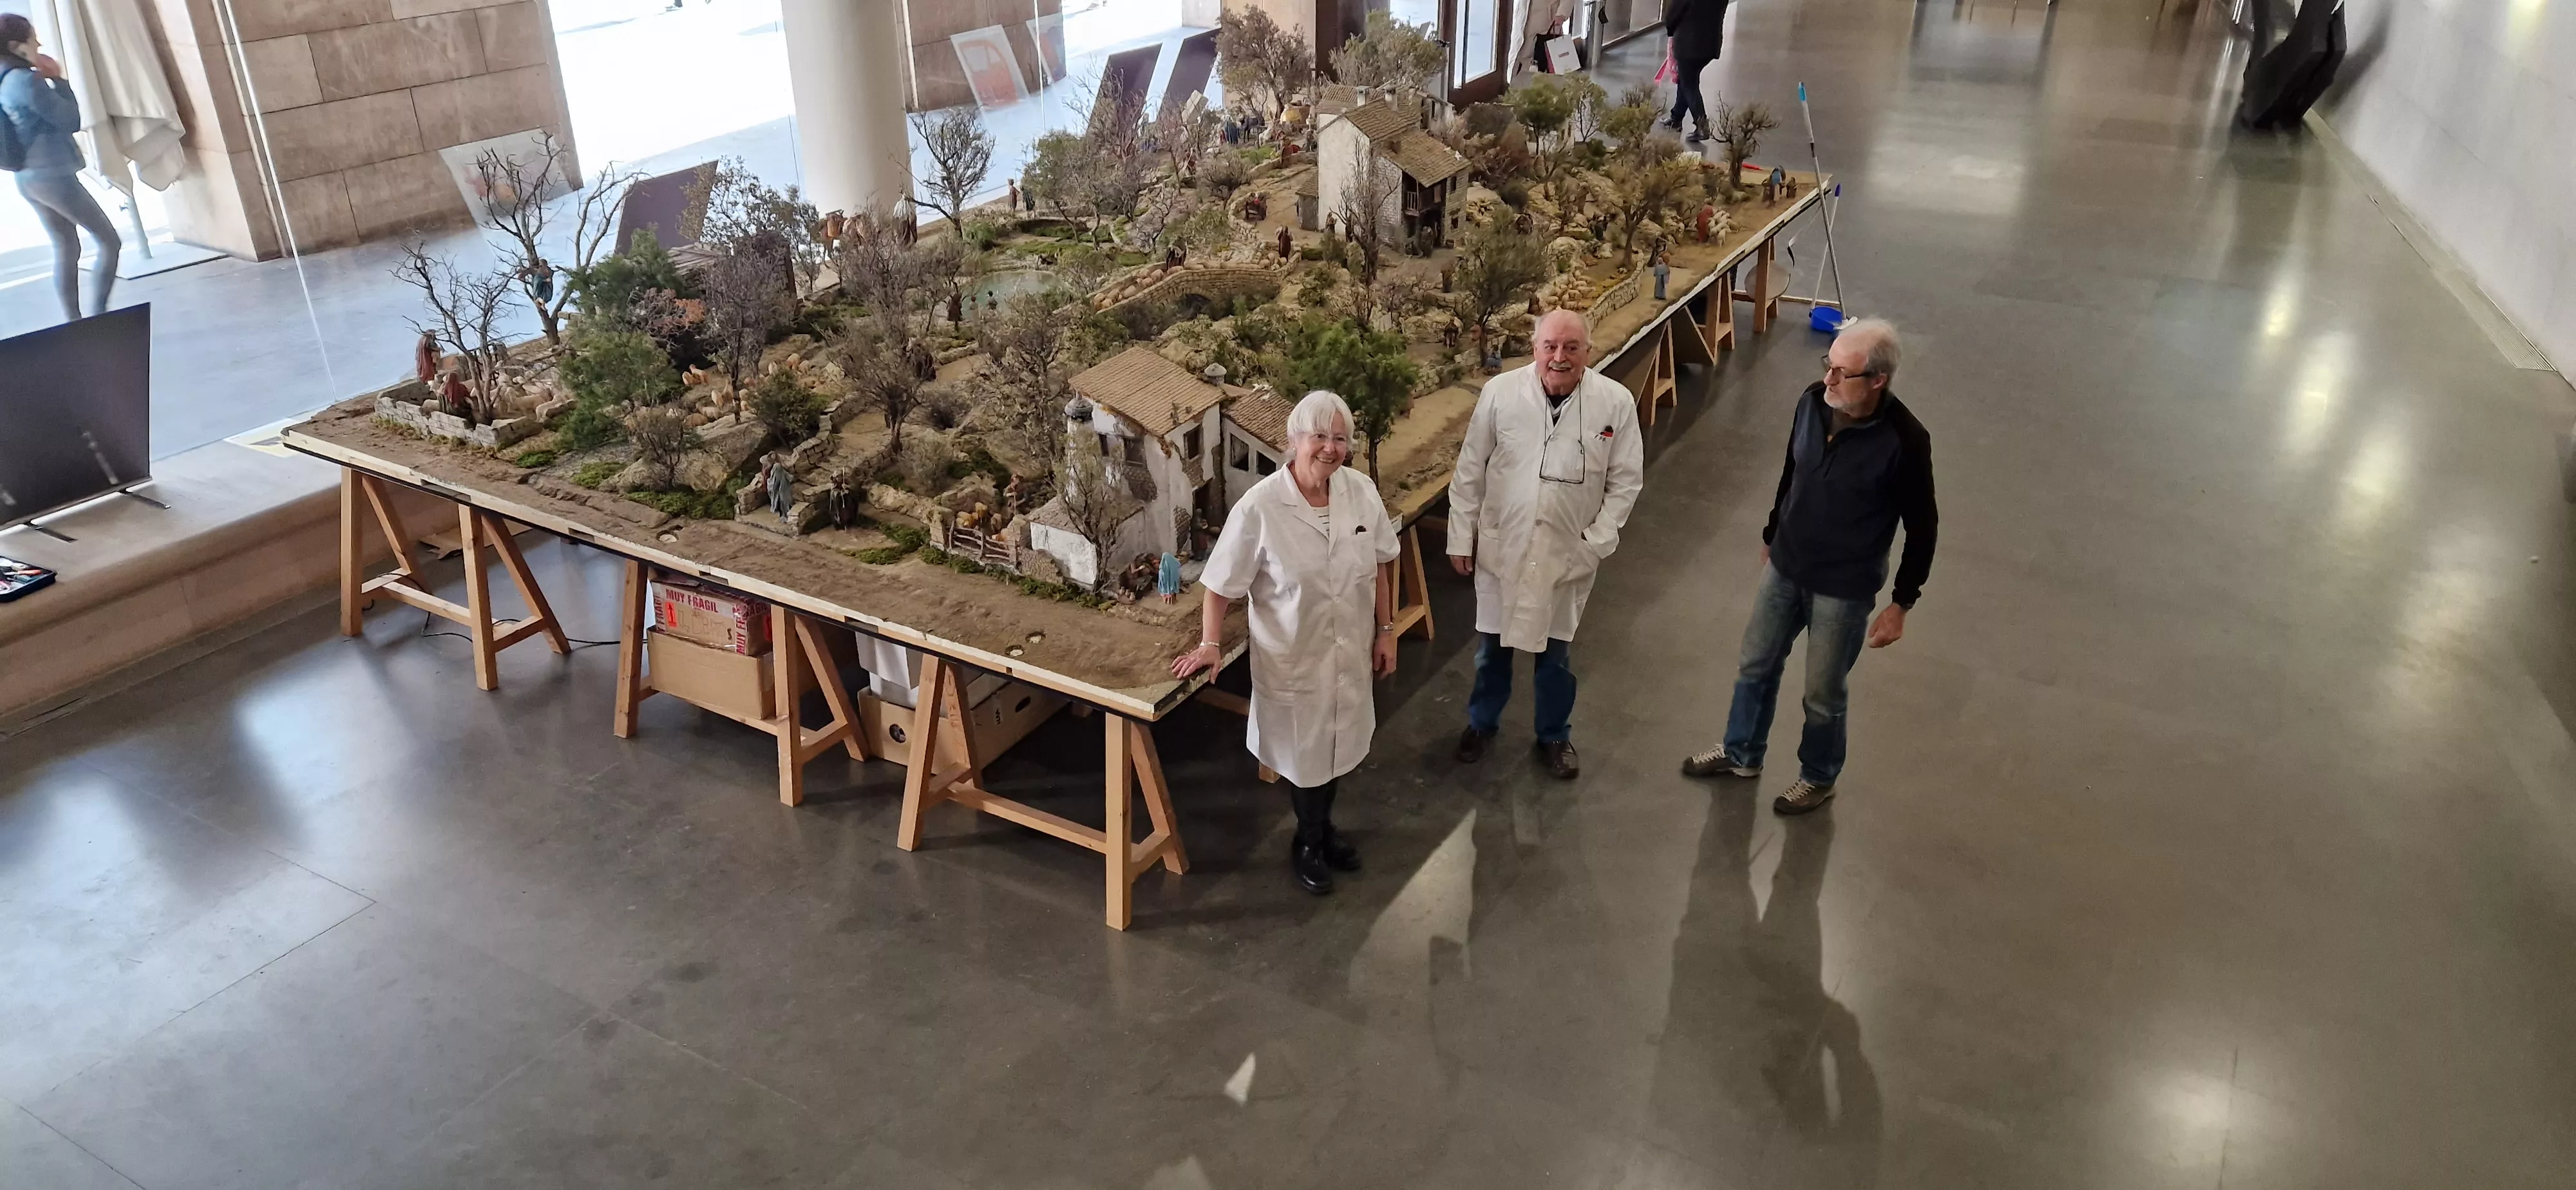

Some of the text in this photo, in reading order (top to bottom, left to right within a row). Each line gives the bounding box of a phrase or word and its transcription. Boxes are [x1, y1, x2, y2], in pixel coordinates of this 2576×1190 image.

[666, 589, 718, 613] MUY FRAGIL
[735, 631, 746, 655] MUY
